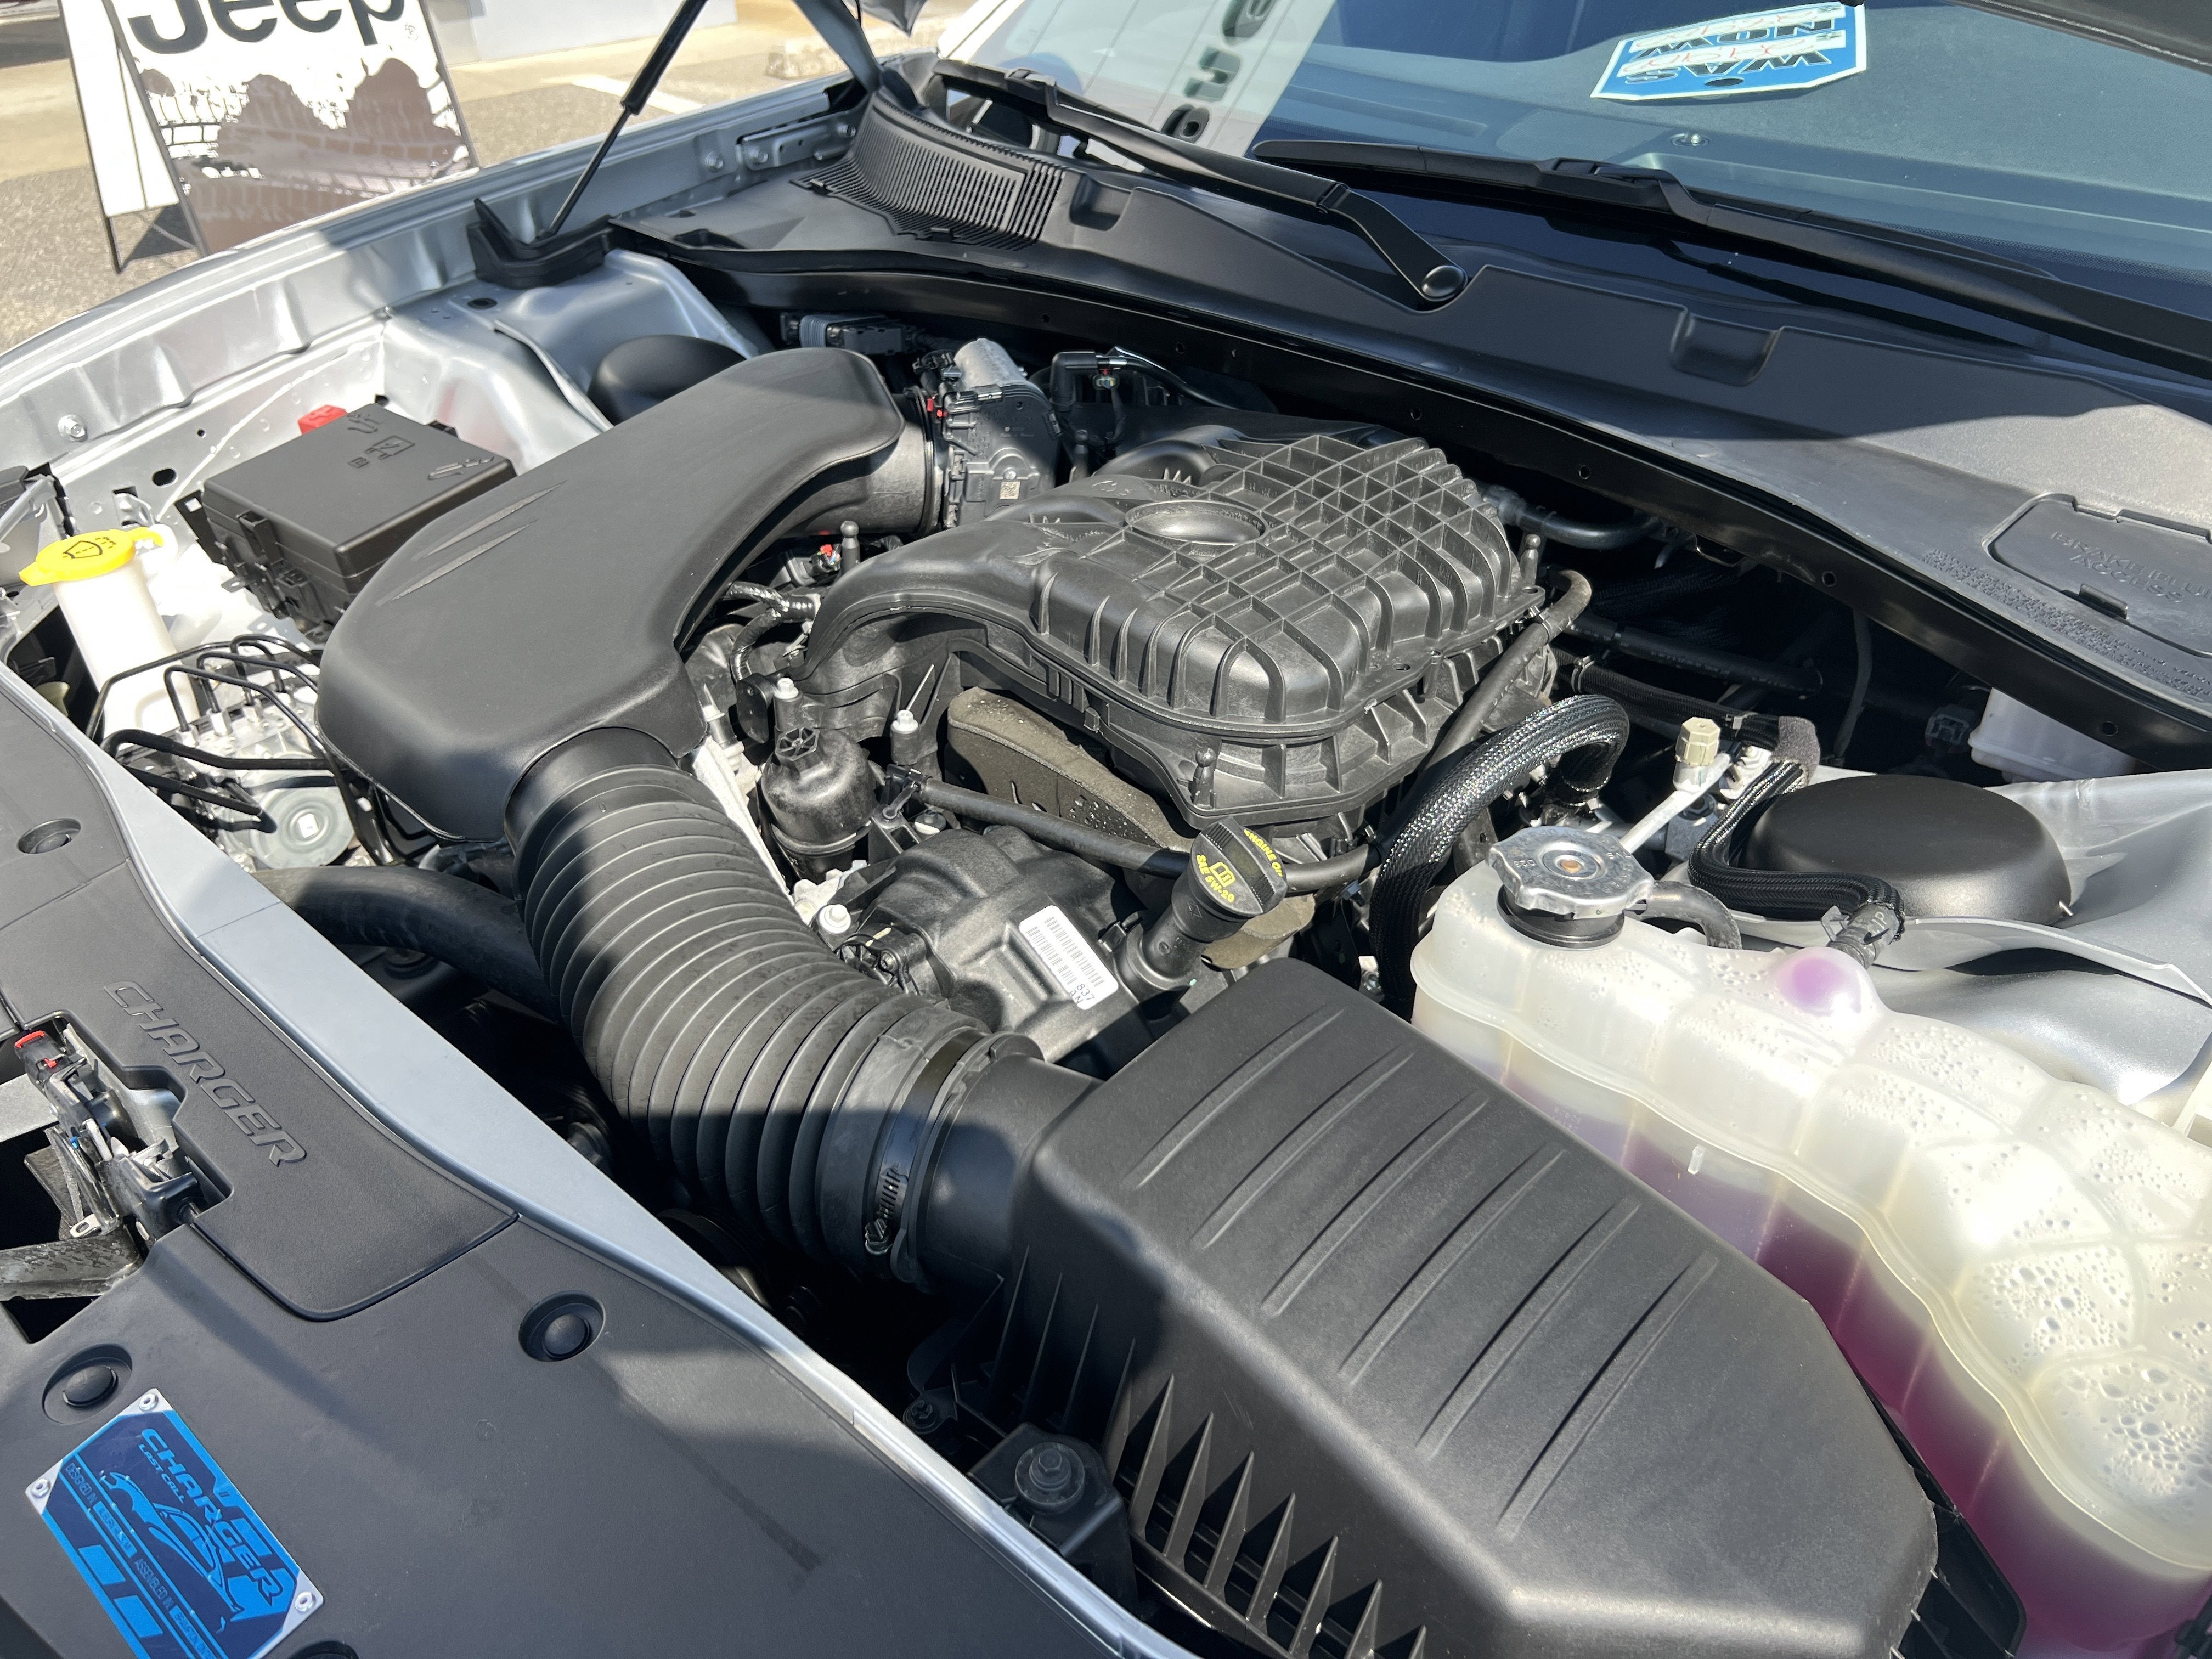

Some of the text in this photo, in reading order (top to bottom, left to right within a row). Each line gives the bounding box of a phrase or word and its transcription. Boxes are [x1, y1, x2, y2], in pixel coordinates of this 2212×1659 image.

[1244, 829, 1277, 861] ENGINE
[1196, 854, 1235, 902] SAE 5W-20
[1076, 983, 1096, 1000] 837
[104, 981, 307, 1167] CHARGER
[138, 1444, 184, 1503] LAST CALL
[142, 1429, 283, 1606] CHARGER
[134, 1558, 168, 1600] ASSEMBLED
